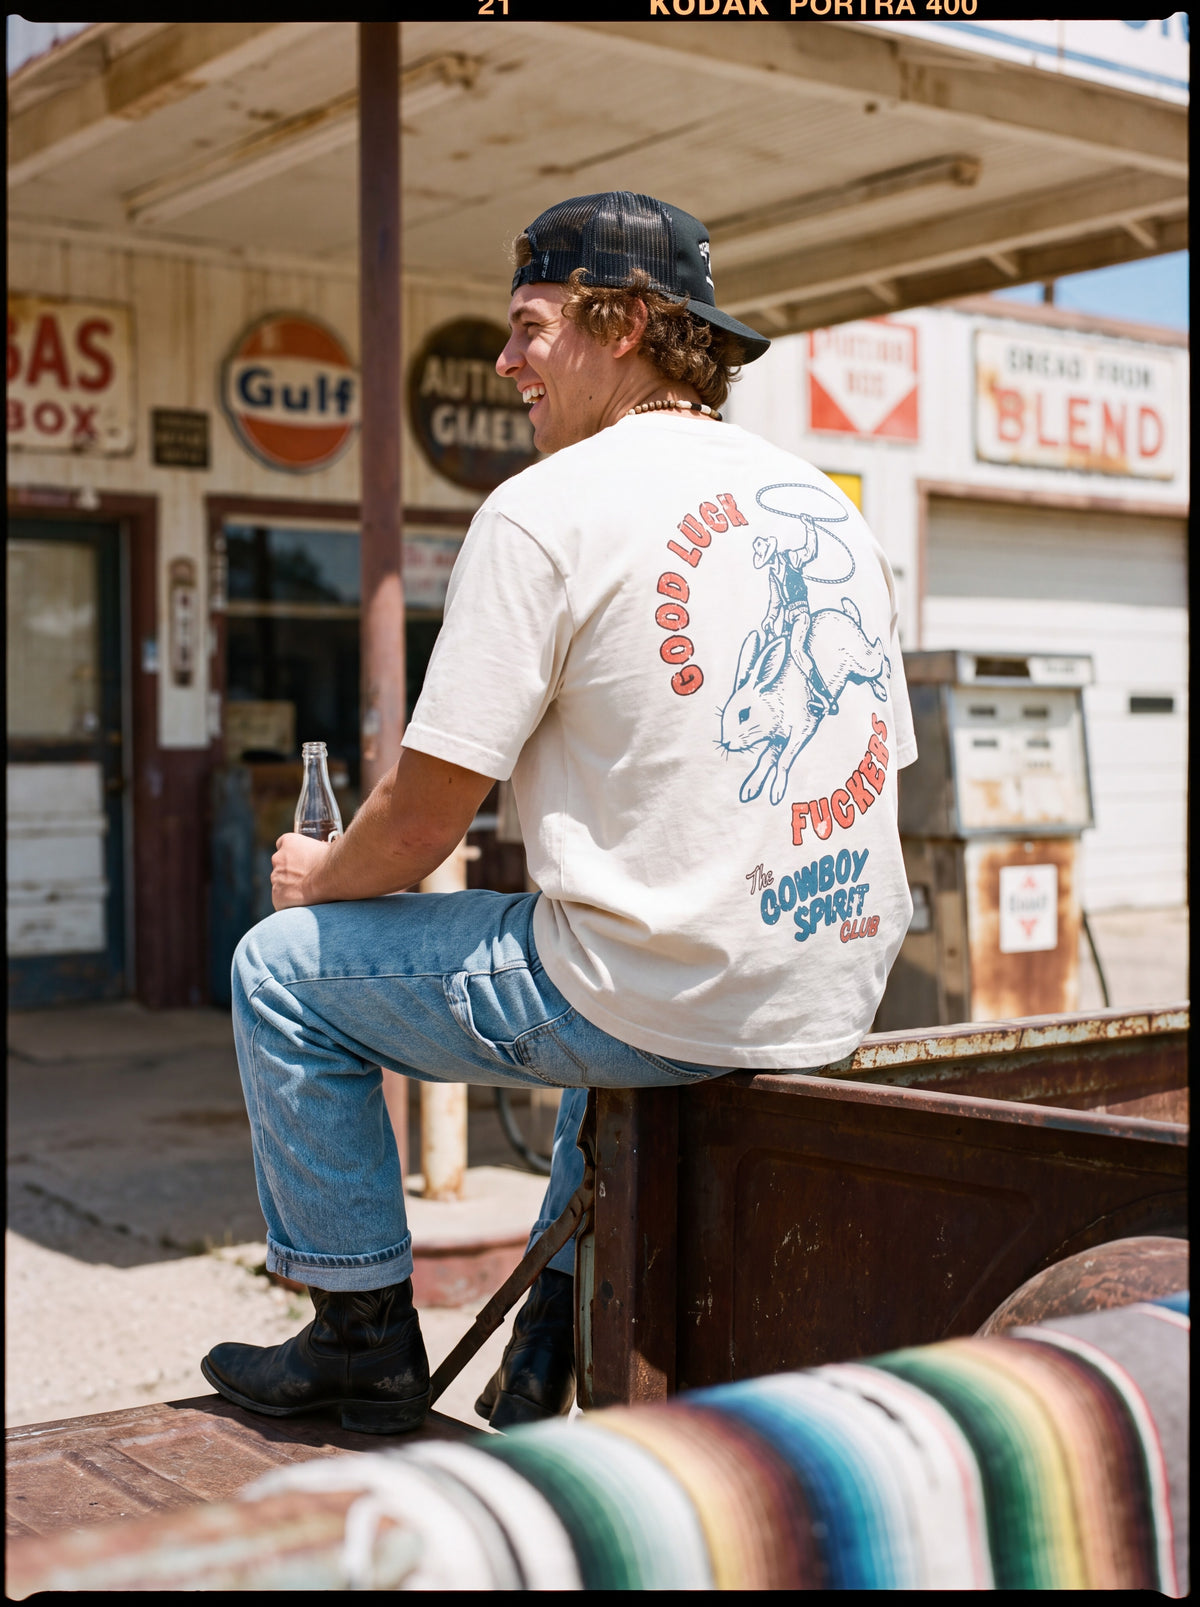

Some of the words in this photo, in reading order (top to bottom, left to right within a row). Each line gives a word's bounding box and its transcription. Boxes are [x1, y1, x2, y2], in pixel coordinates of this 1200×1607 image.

[238, 366, 353, 416] Gulf
[993, 387, 1165, 460] BLEND
[667, 493, 749, 568] LUCK
[655, 571, 704, 696] GOOD
[791, 713, 889, 846] FUCKERS
[746, 863, 774, 895] The
[760, 848, 870, 926] COWBOY
[794, 884, 870, 943] SPIRIT
[840, 914, 881, 944] CLUB
